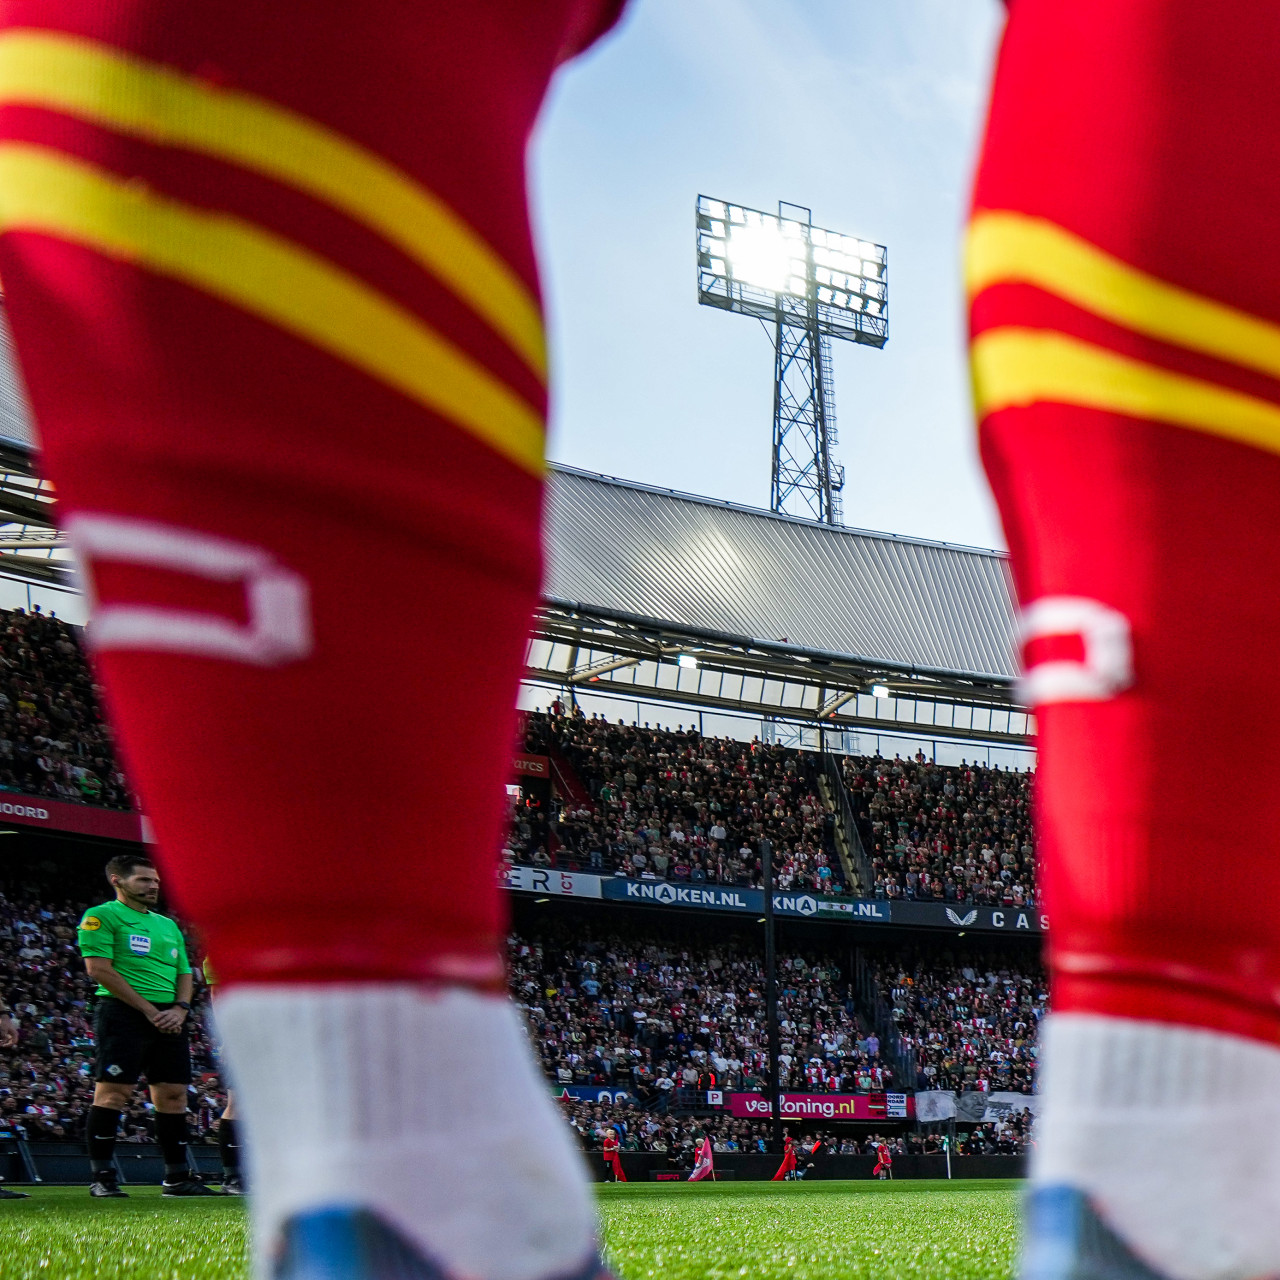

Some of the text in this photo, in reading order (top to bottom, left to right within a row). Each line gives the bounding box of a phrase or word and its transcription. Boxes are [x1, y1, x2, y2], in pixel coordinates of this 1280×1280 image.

[511, 757, 545, 773] arcs
[0, 802, 48, 819] OORD
[550, 872, 573, 894] ICT
[627, 883, 746, 907] KNAKEN.NL
[772, 894, 883, 918] KNA.NL
[711, 1093, 719, 1103] P
